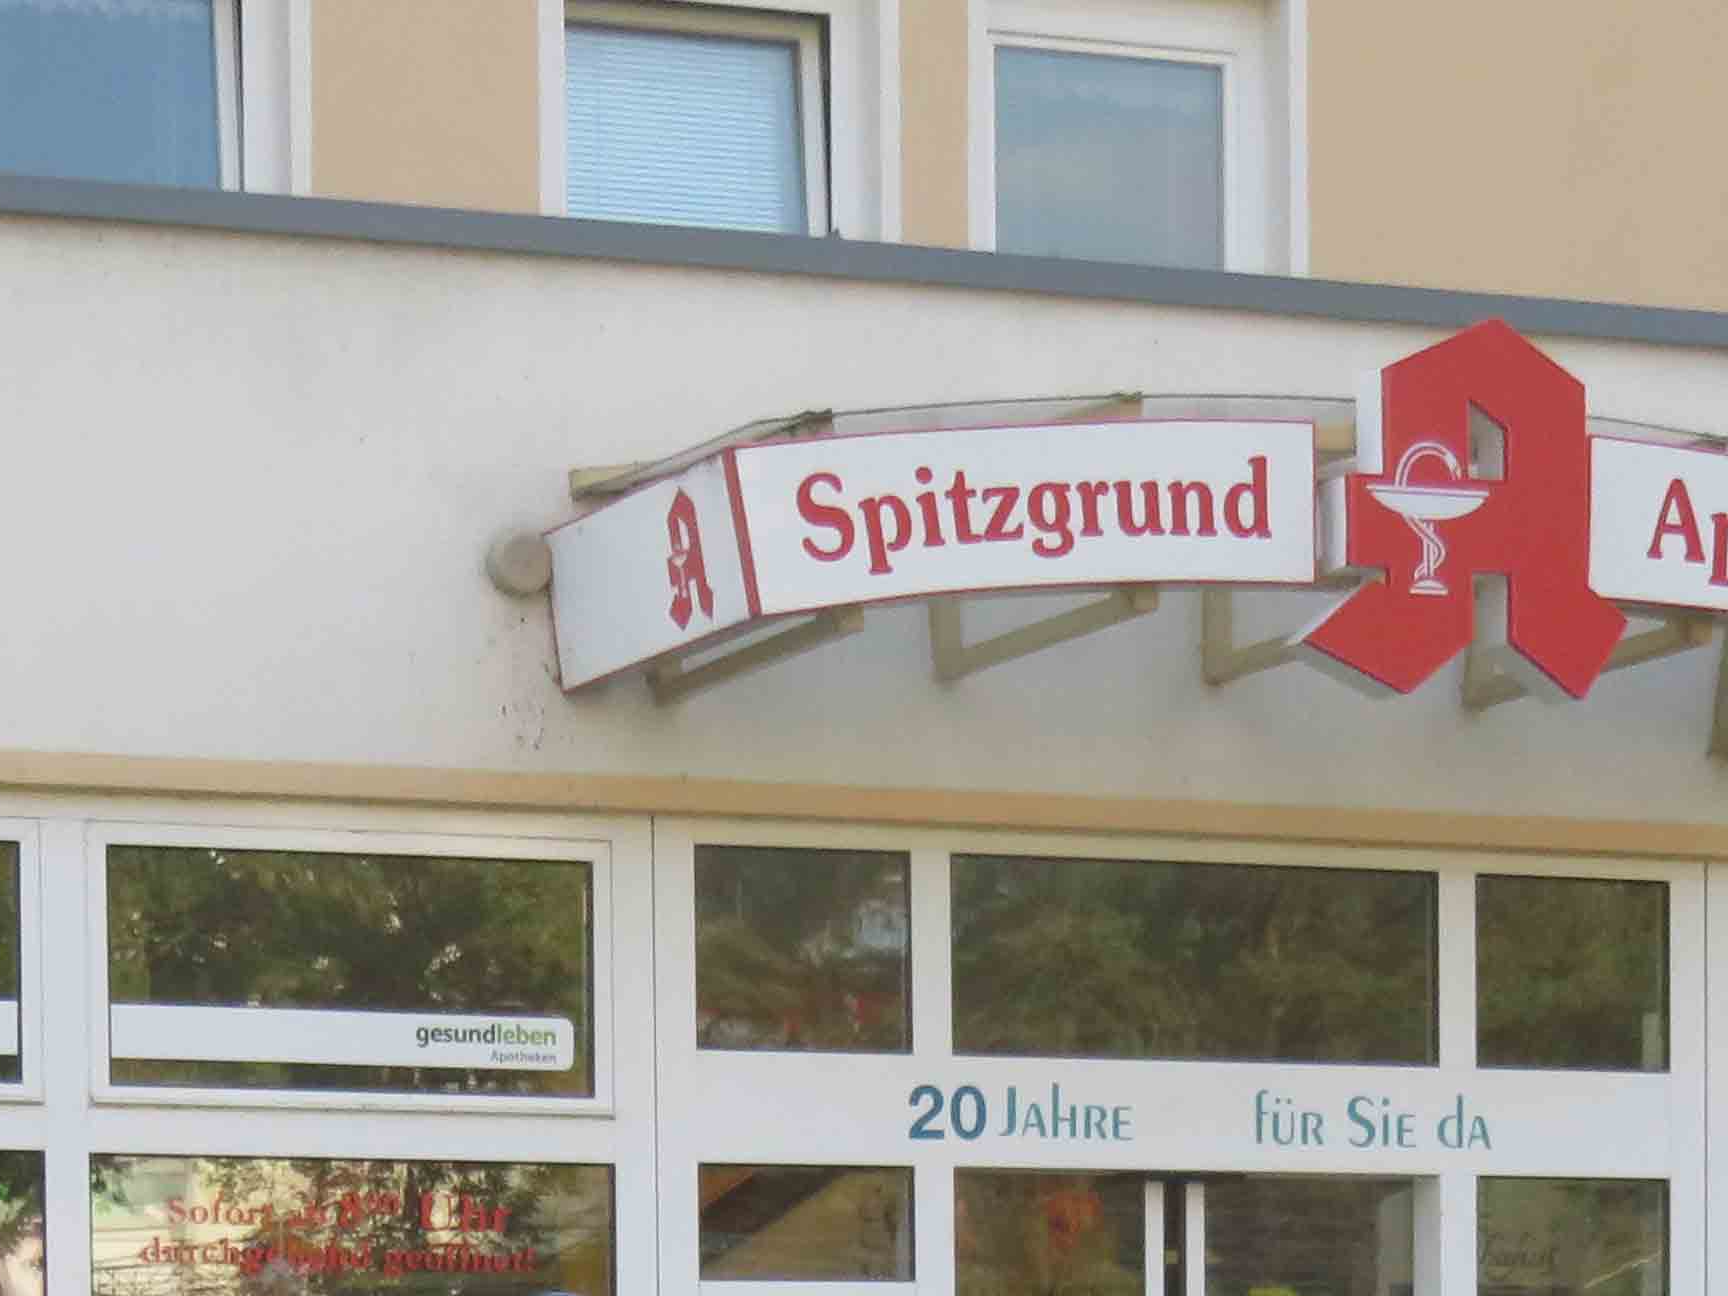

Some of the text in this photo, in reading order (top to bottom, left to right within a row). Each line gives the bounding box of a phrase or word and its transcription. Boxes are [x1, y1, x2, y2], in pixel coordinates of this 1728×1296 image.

[796, 455, 1273, 575] Spitzgrund
[415, 1023, 558, 1049] gesundleben
[907, 1083, 987, 1141] 20
